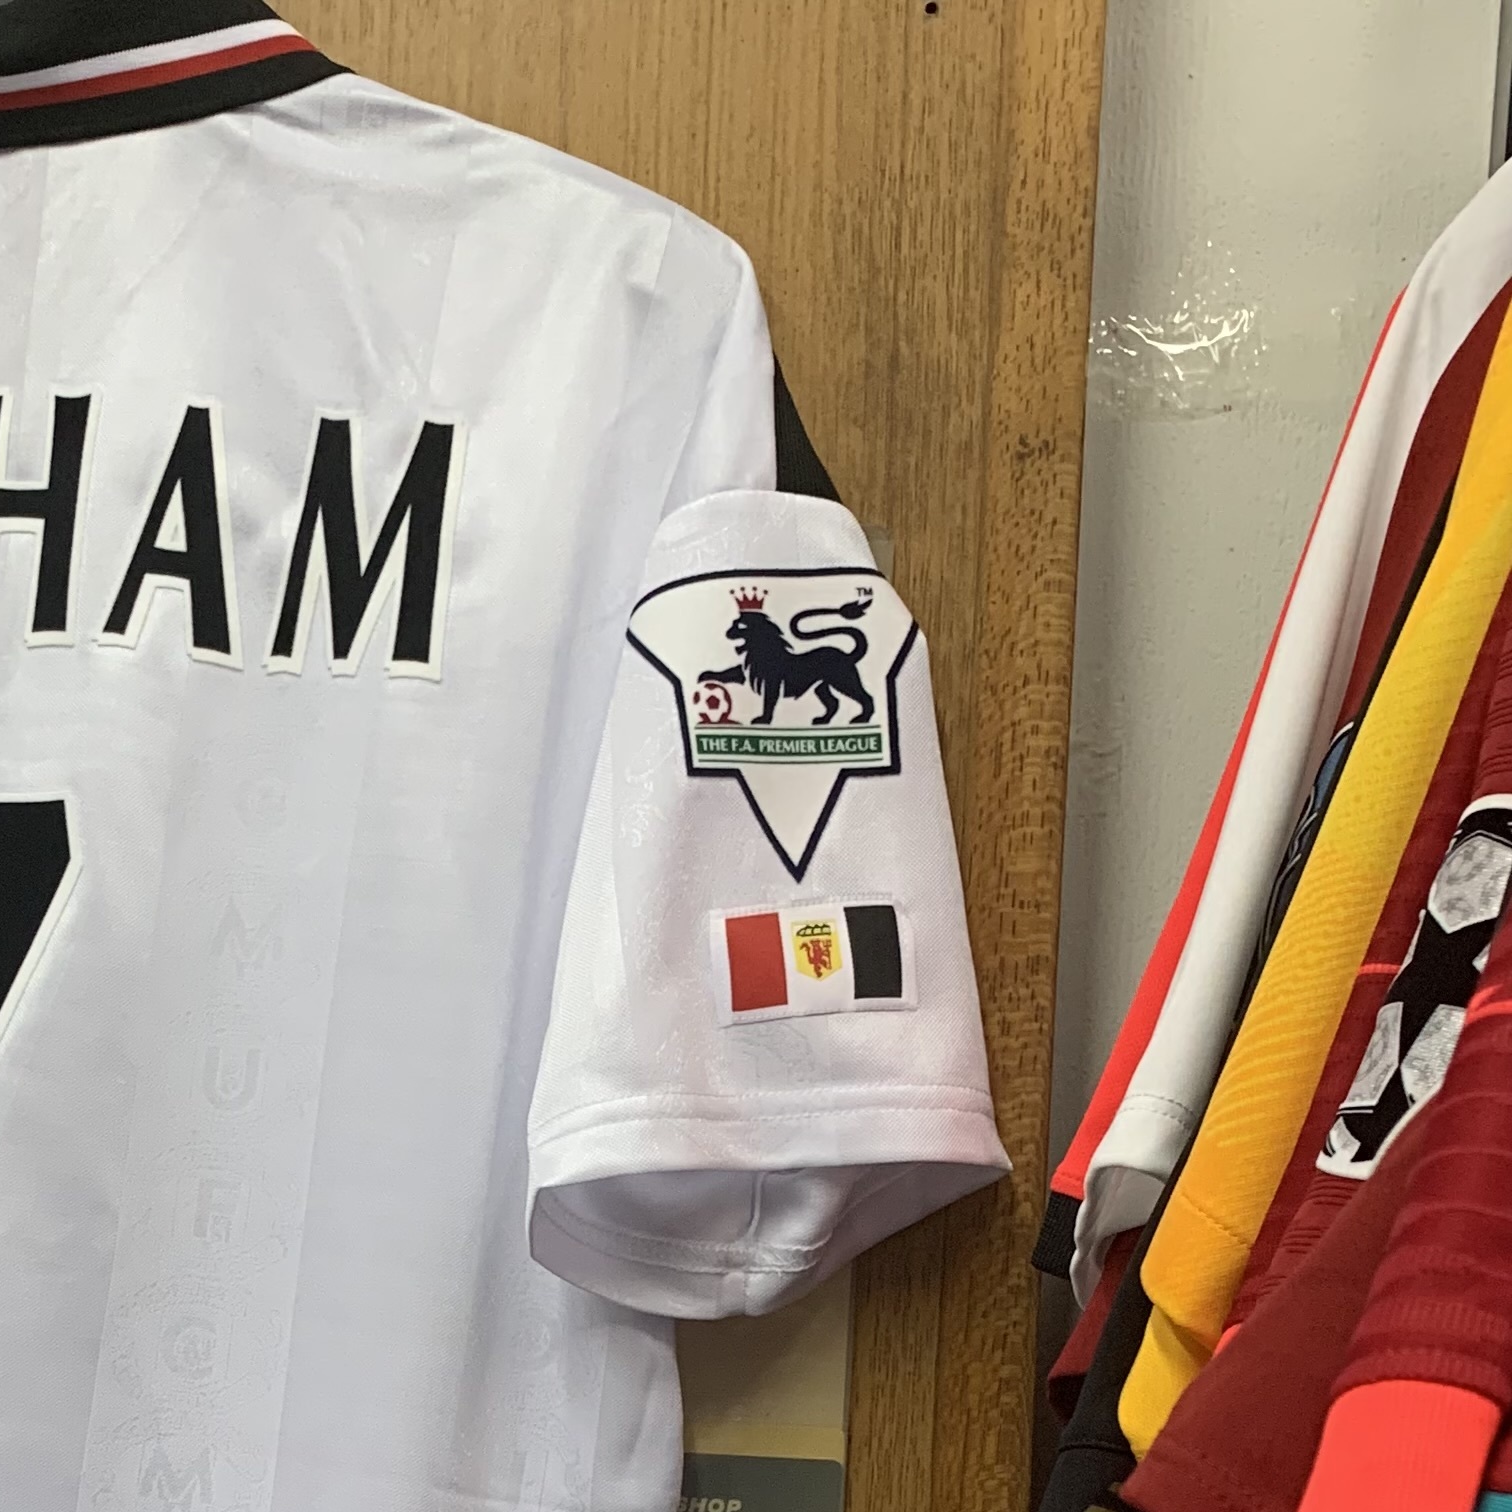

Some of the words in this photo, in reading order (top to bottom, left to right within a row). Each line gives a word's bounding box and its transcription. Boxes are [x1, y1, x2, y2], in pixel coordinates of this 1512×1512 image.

[699, 736, 729, 751] THE
[731, 738, 756, 752] F.A.
[759, 739, 817, 753] PREMIER
[819, 736, 878, 752] LEAGUE
